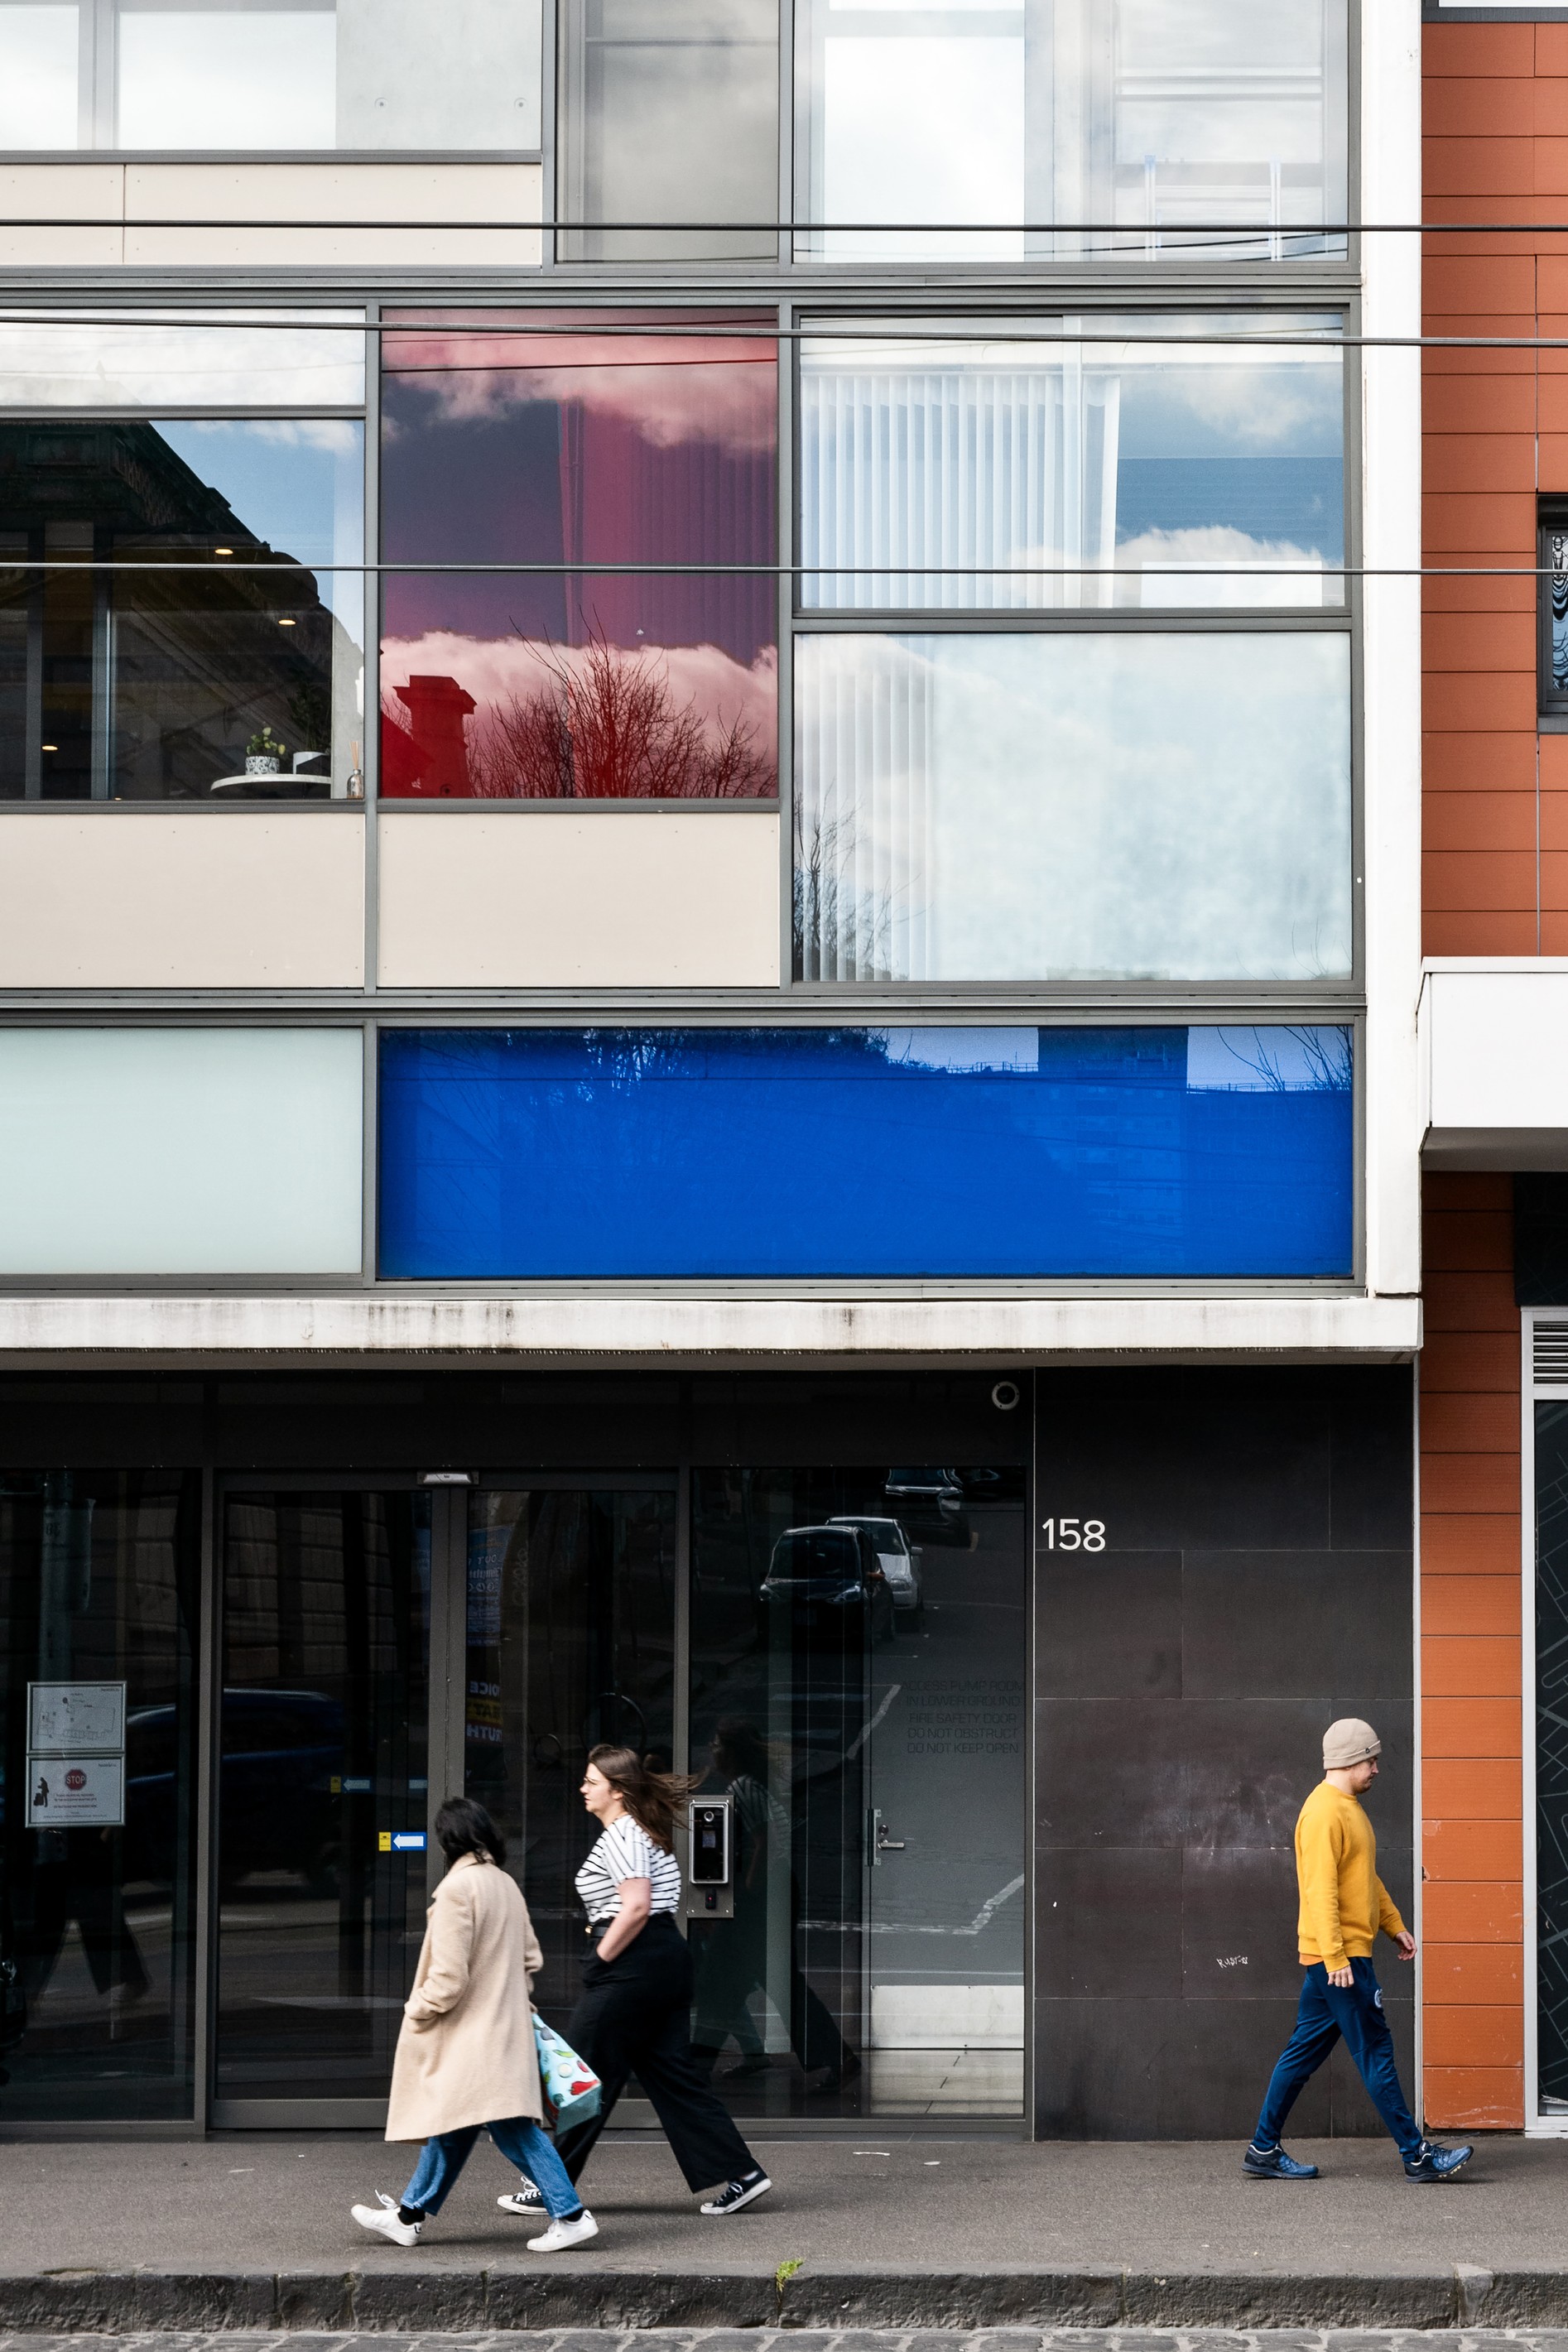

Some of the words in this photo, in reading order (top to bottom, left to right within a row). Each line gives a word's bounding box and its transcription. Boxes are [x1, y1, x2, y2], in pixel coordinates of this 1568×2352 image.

[1042, 1518, 1105, 1551] 158
[902, 1681, 947, 1691] ACCESS
[950, 1681, 986, 1691] PUMP
[921, 1695, 964, 1706] LOWER
[968, 1695, 1021, 1706] GROUND
[909, 1713, 933, 1724] FIRE
[936, 1713, 980, 1724] SAFETY
[984, 1713, 1017, 1724] DOOR
[907, 1728, 925, 1739] DO
[927, 1728, 951, 1739] NOT
[955, 1728, 1017, 1739] OBSTRUCT
[907, 1743, 924, 1753] DO
[926, 1743, 951, 1753] NOT
[955, 1743, 984, 1753] KEEP
[986, 1743, 1019, 1753] OPEN
[66, 1775, 85, 1785] STOP
